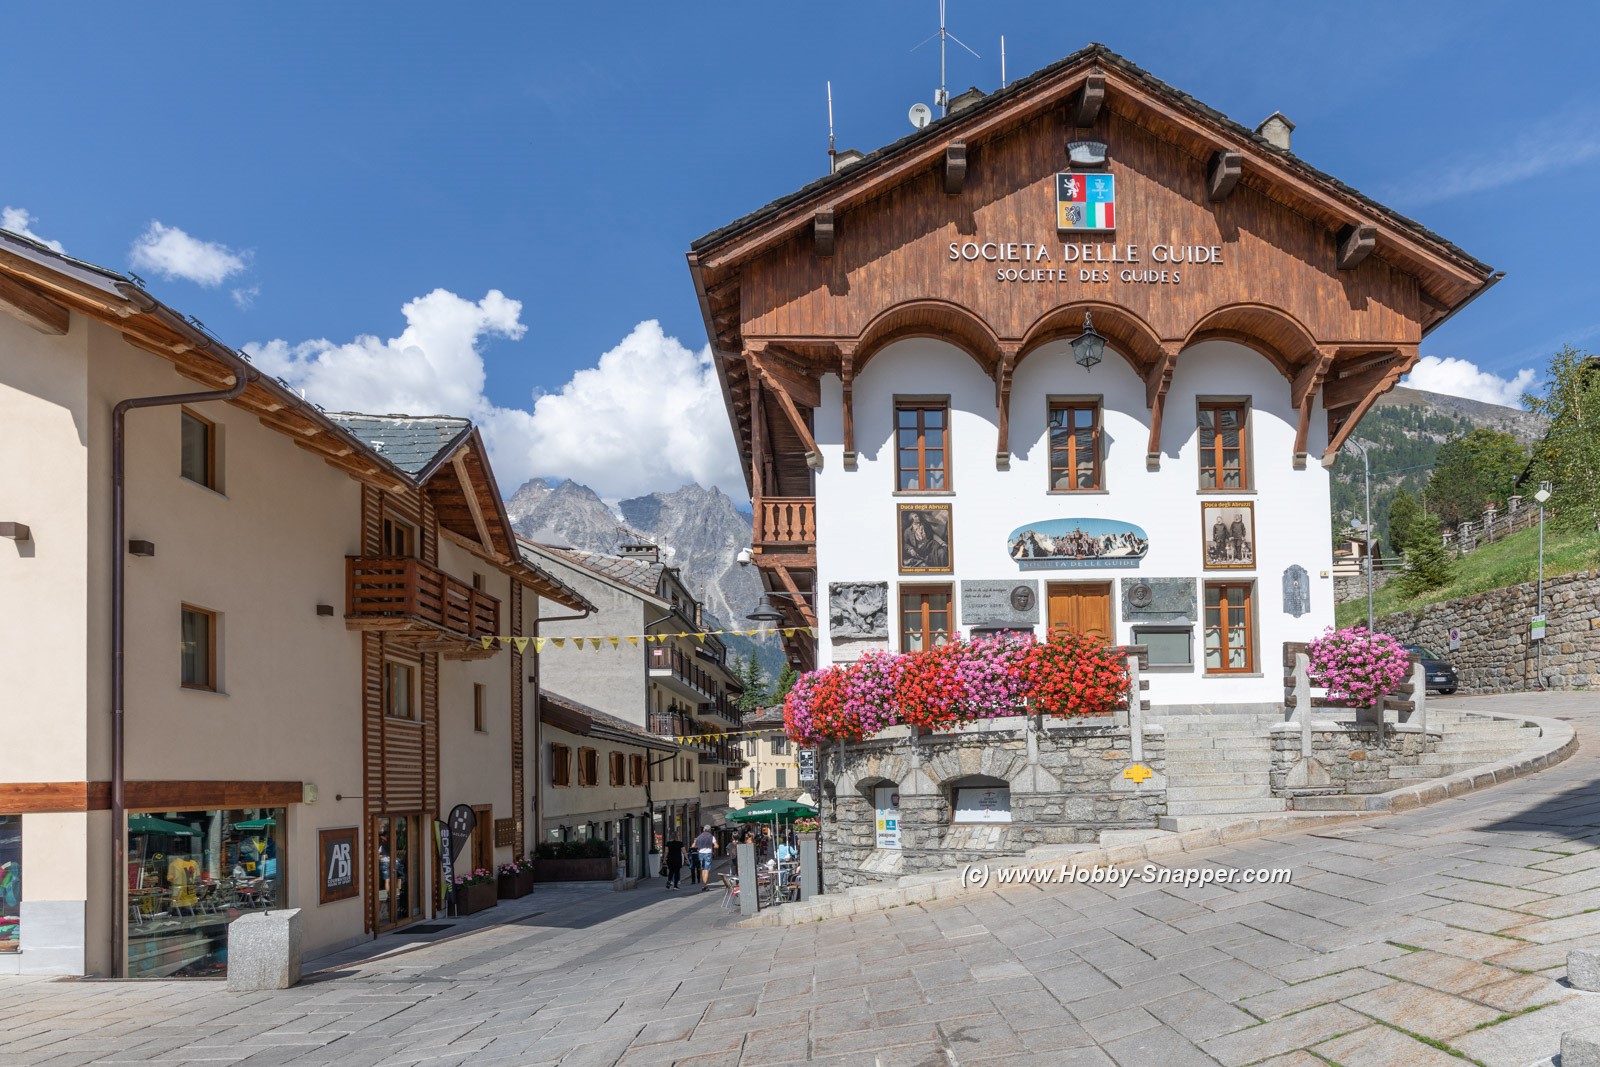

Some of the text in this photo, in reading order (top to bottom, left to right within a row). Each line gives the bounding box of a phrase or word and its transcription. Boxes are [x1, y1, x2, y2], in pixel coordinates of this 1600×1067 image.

[949, 242, 1224, 265] SOCIETA DELLE GUIDE
[997, 268, 1181, 284] SOCIETE DES GUIDES
